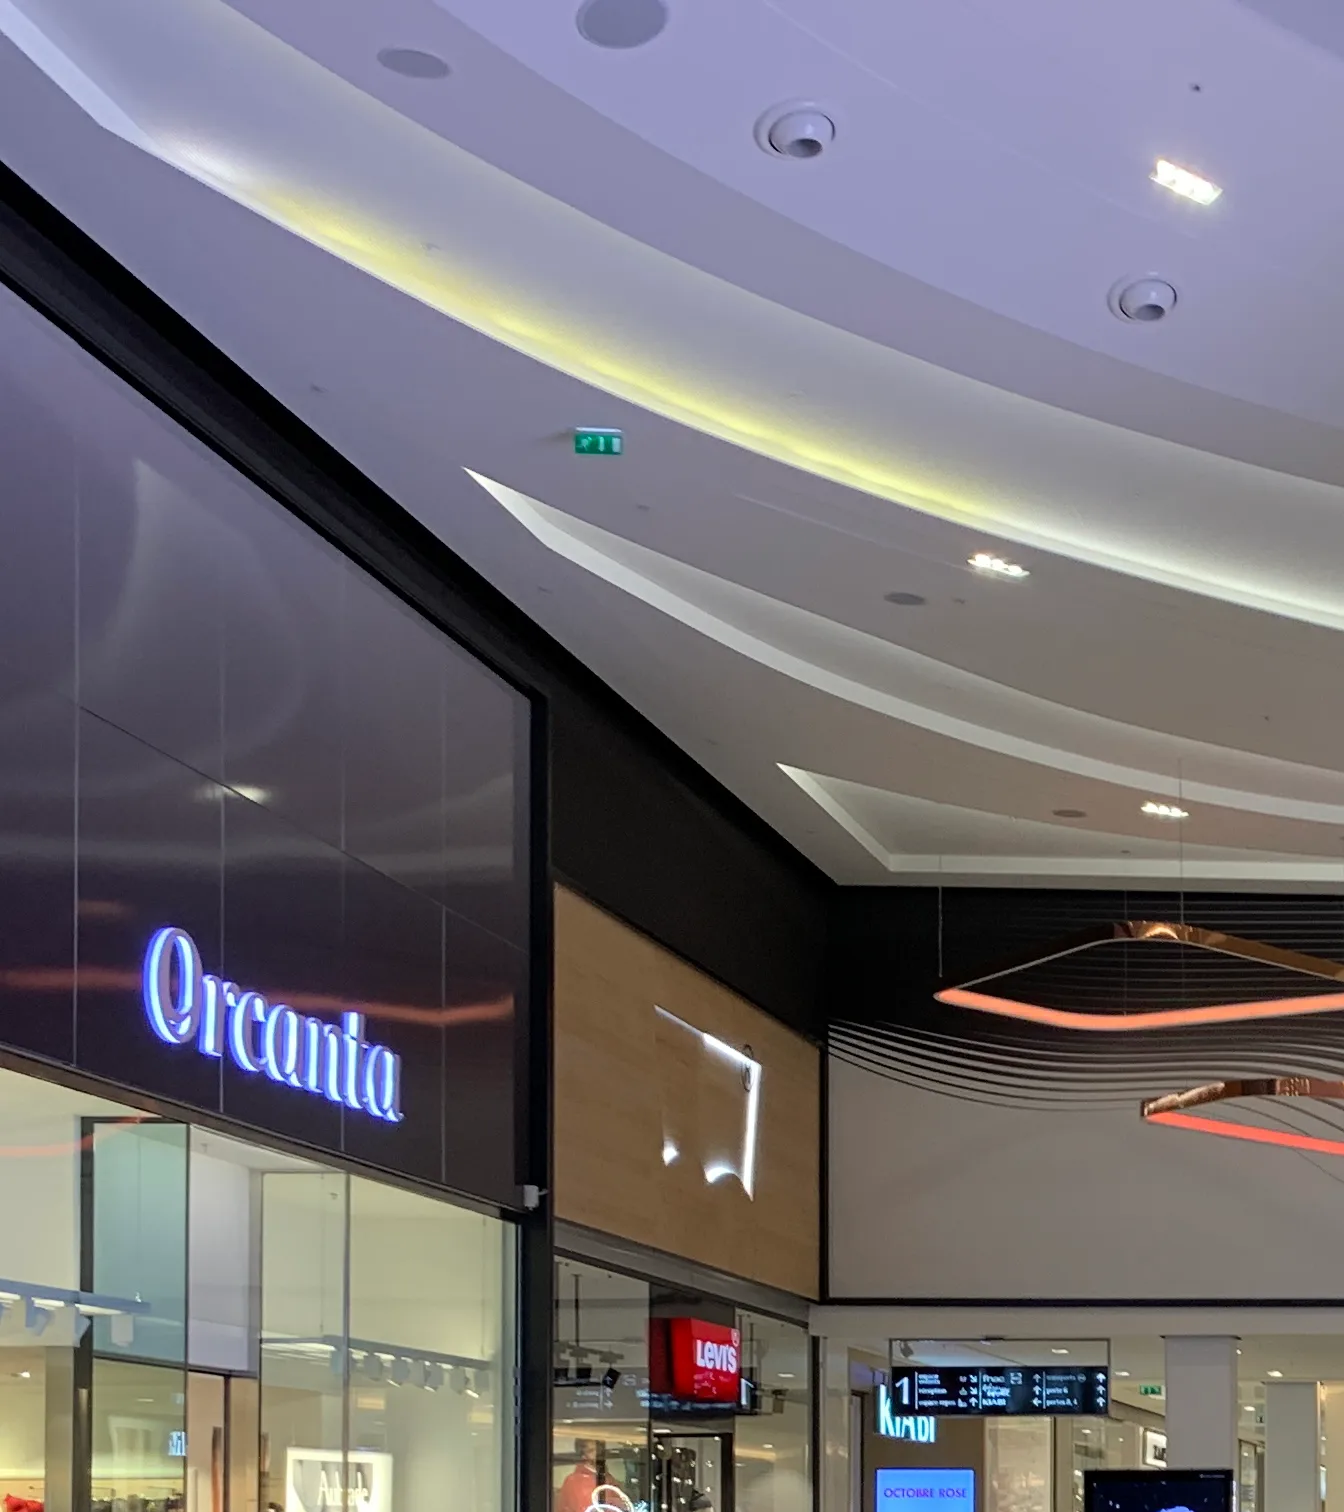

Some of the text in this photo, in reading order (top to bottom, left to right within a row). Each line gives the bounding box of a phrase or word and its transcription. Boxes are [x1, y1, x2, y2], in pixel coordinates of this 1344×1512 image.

[143, 927, 404, 1122] Orcanta
[895, 1376, 909, 1405] 1
[884, 1488, 967, 1498] OCTOBRE ROSE
